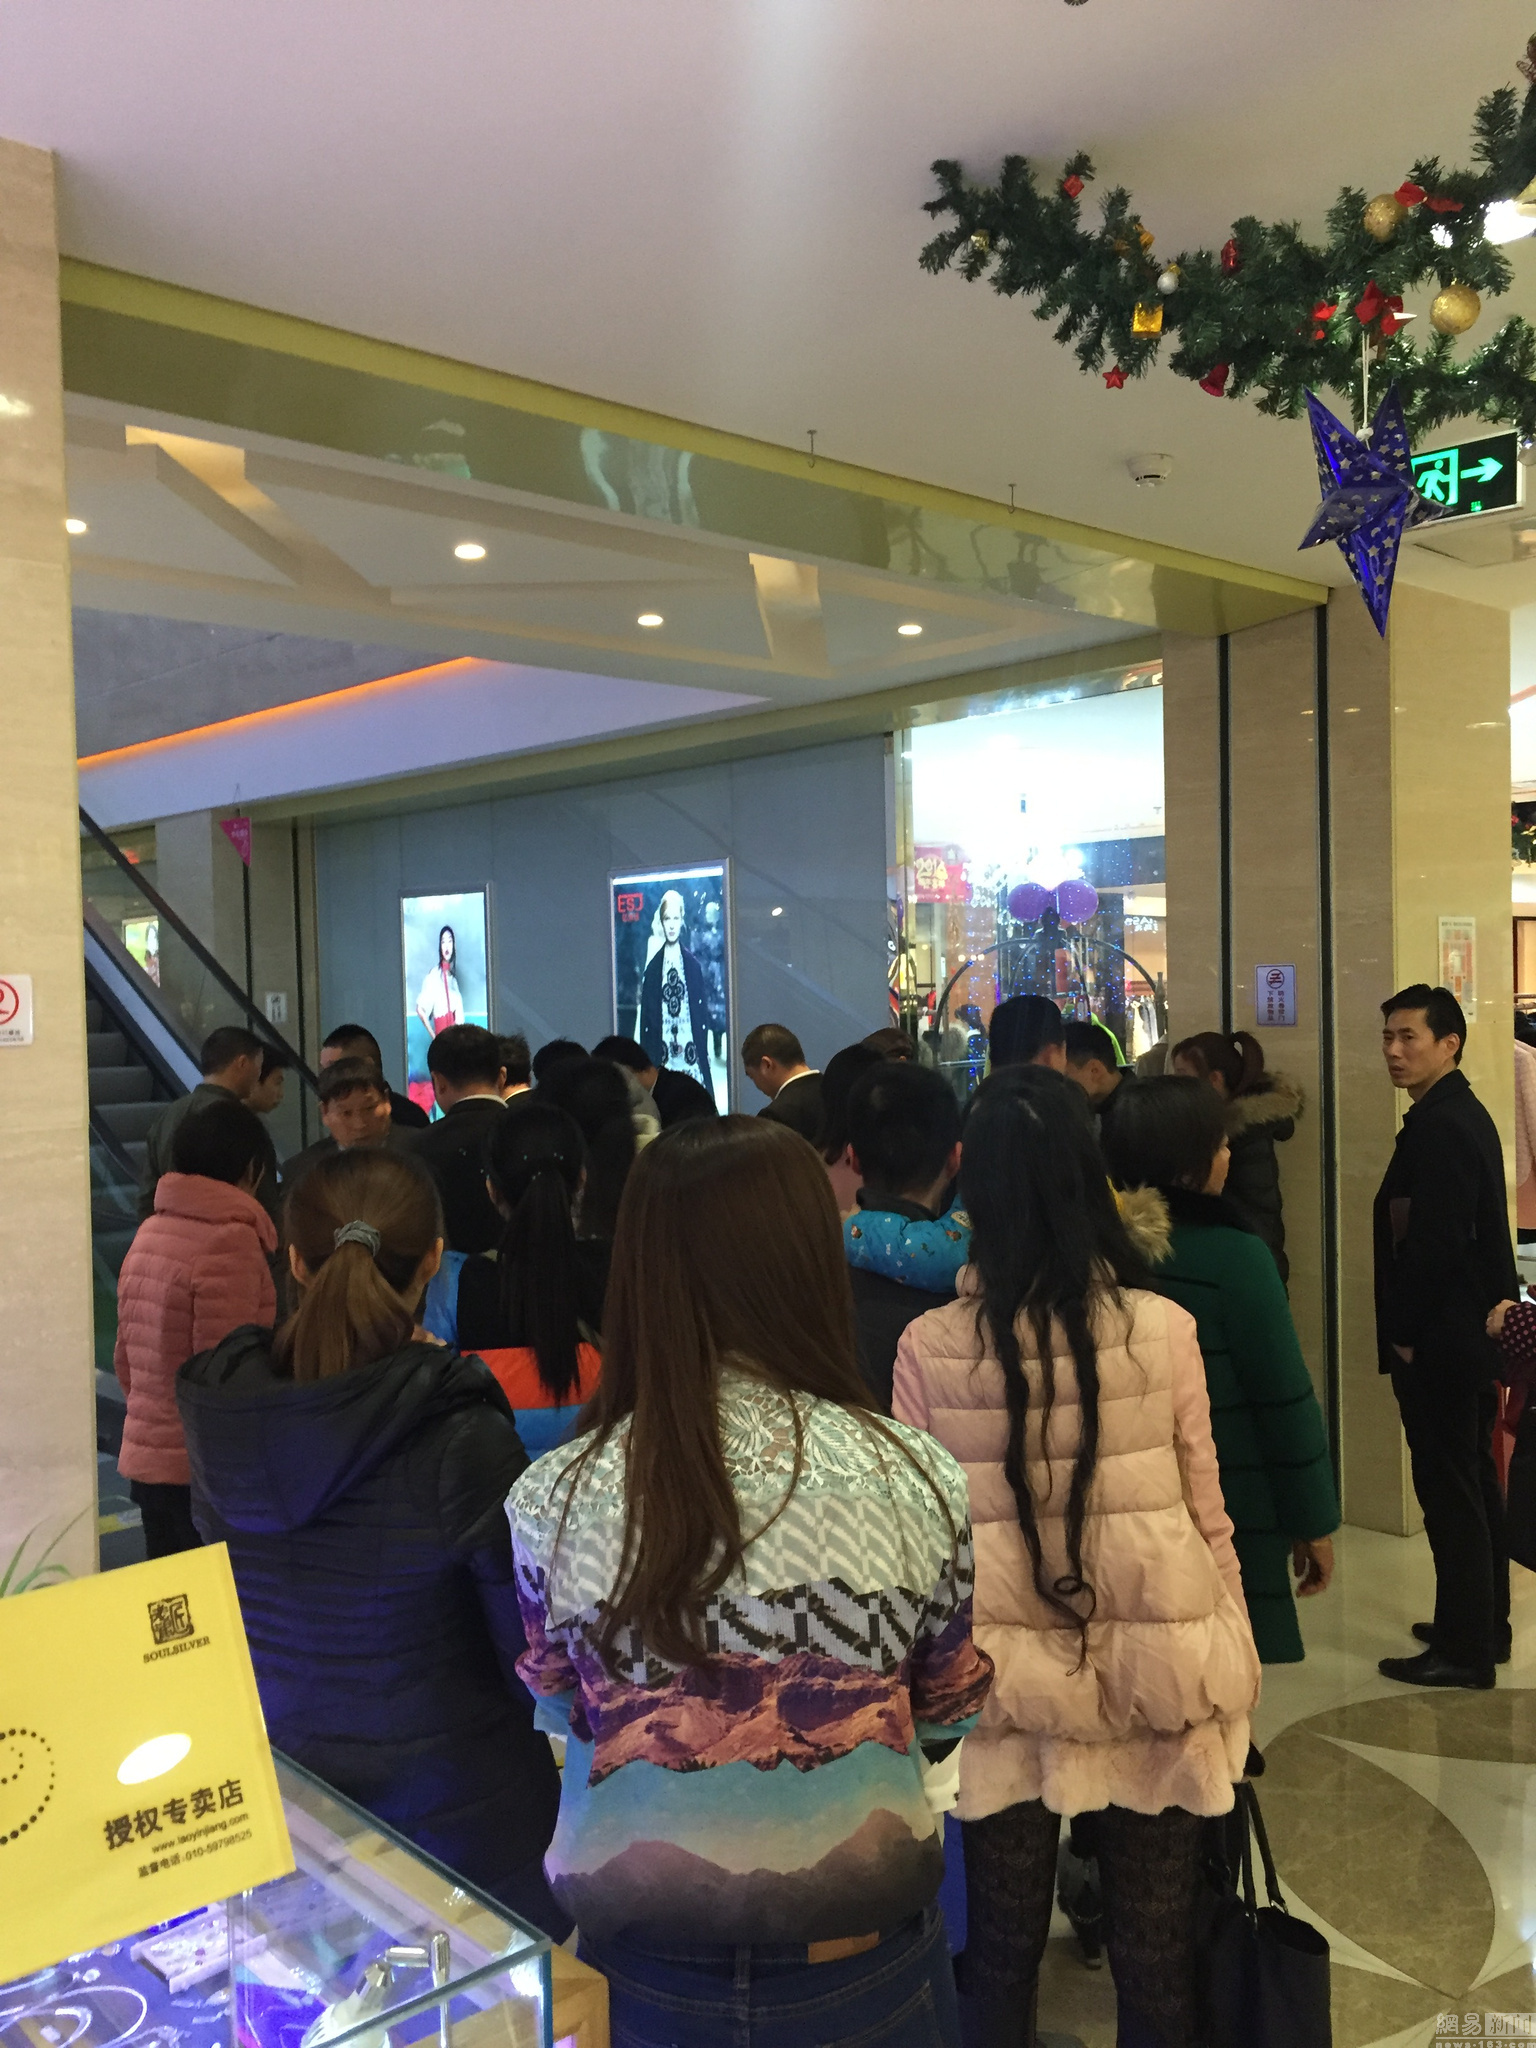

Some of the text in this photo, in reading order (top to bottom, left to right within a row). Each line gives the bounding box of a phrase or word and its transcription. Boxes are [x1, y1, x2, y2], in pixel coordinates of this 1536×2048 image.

[143, 1635, 211, 1664] SOULSILVER
[103, 1778, 245, 1851] 授权专卖店
